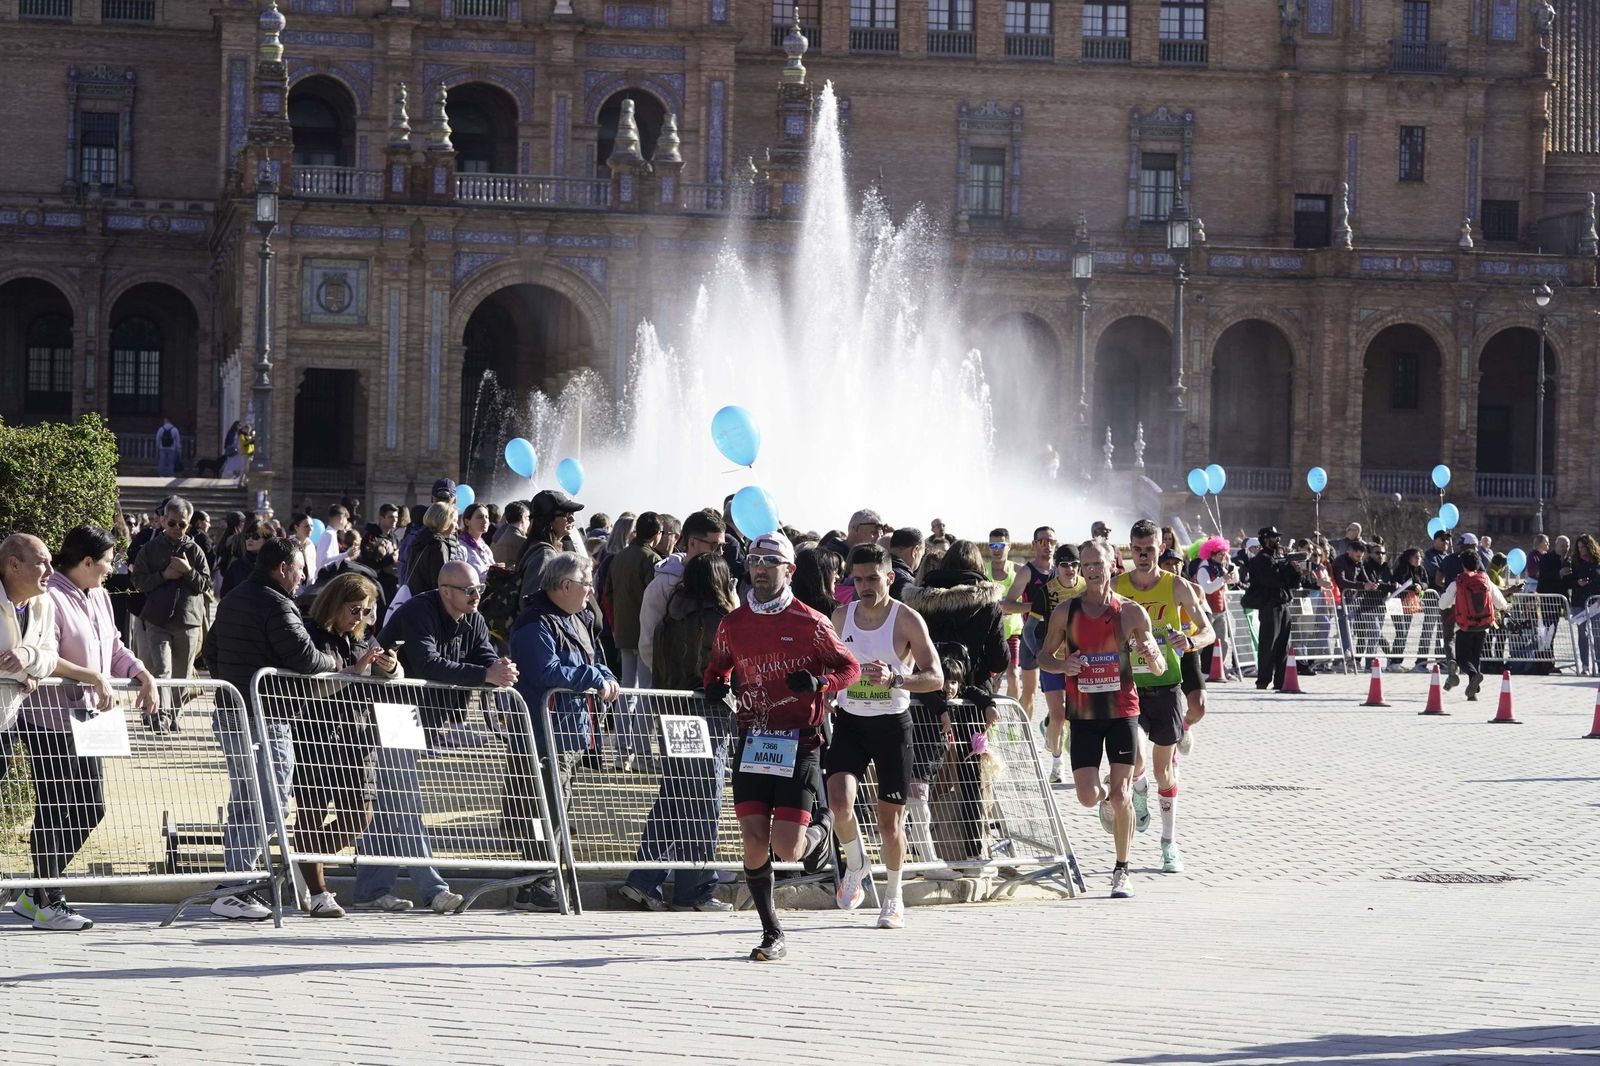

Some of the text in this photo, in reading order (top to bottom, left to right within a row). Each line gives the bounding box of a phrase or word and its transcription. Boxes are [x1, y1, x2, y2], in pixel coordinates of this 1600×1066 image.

[756, 654, 813, 674] MARATÓN
[847, 690, 868, 699] MIGUEL
[762, 742, 778, 751] 7366
[754, 751, 784, 764] MANU
